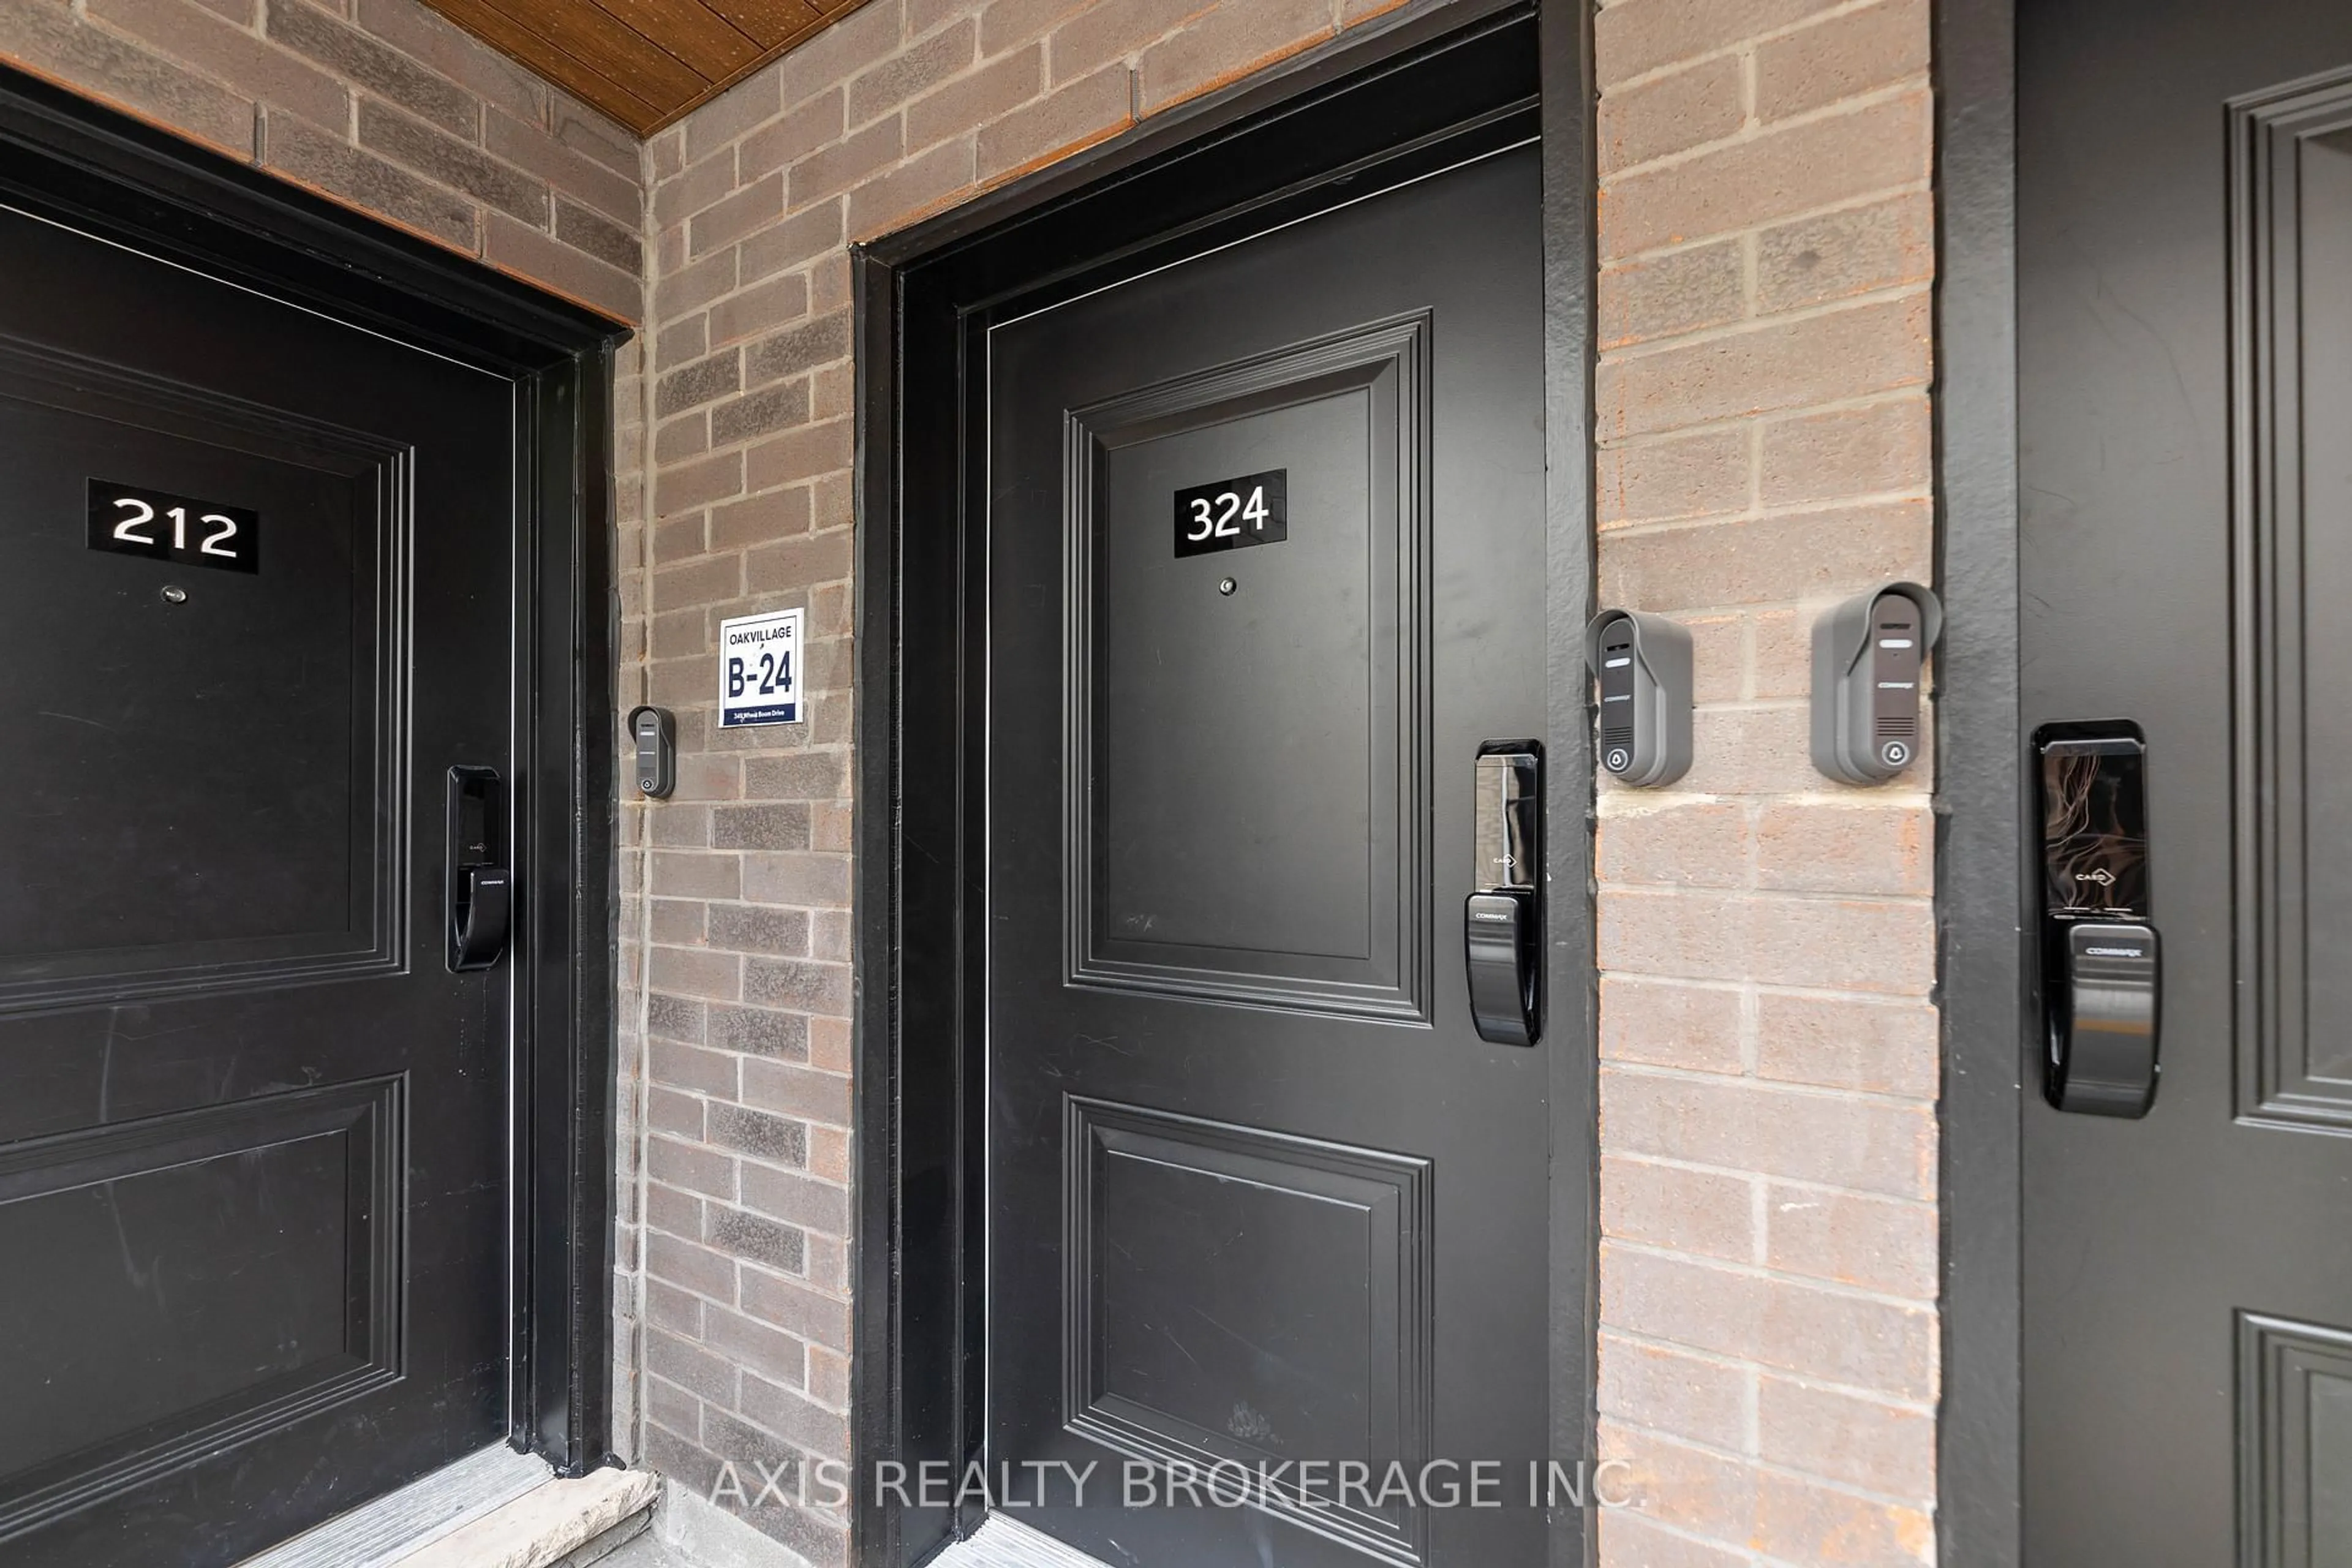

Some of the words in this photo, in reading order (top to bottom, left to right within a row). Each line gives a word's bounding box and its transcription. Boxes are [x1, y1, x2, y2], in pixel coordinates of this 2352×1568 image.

[113, 498, 238, 558] 212
[1187, 486, 1269, 541] 324
[729, 626, 791, 645] OAKVILLAGE
[729, 650, 792, 698] B-24
